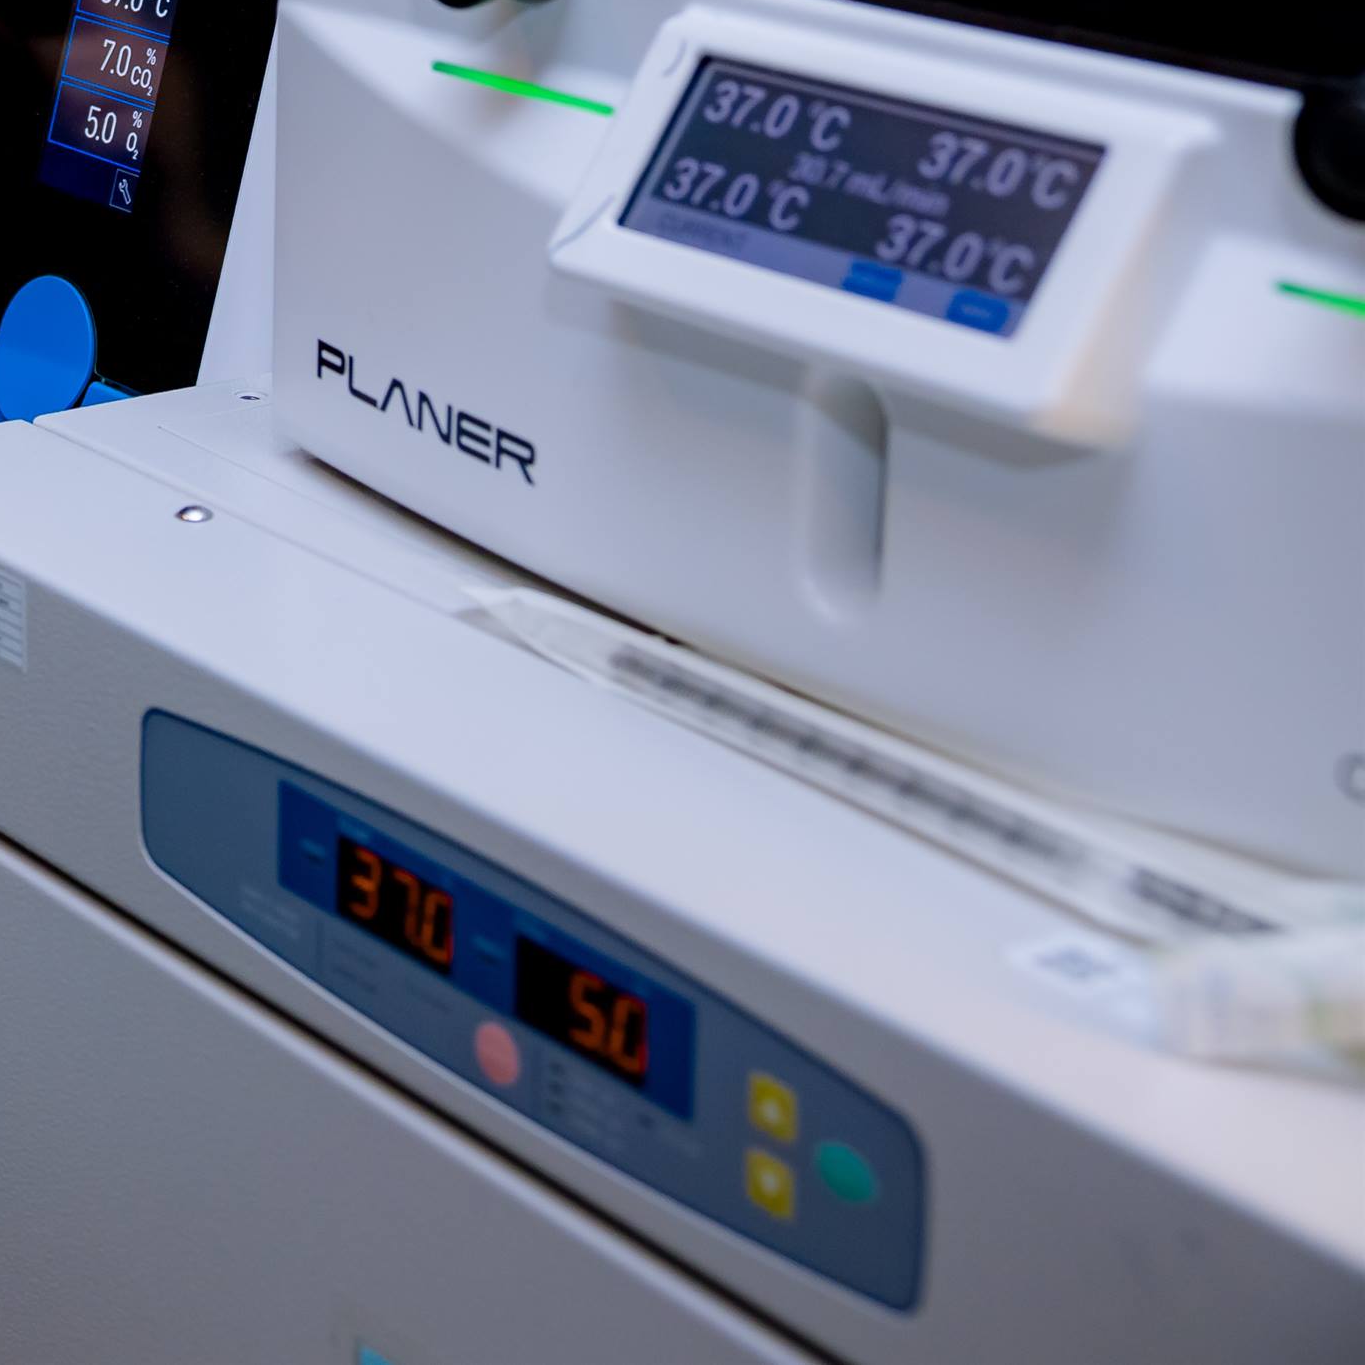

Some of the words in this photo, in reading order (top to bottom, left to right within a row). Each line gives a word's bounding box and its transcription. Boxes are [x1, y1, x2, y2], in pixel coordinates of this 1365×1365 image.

[100, 38, 132, 77] 7.0
[145, 47, 157, 66] %
[84, 105, 117, 144] 5.0
[132, 110, 143, 129] %
[703, 79, 801, 139] 37.0
[662, 156, 761, 218] 37.0
[317, 338, 535, 486] PLANER
